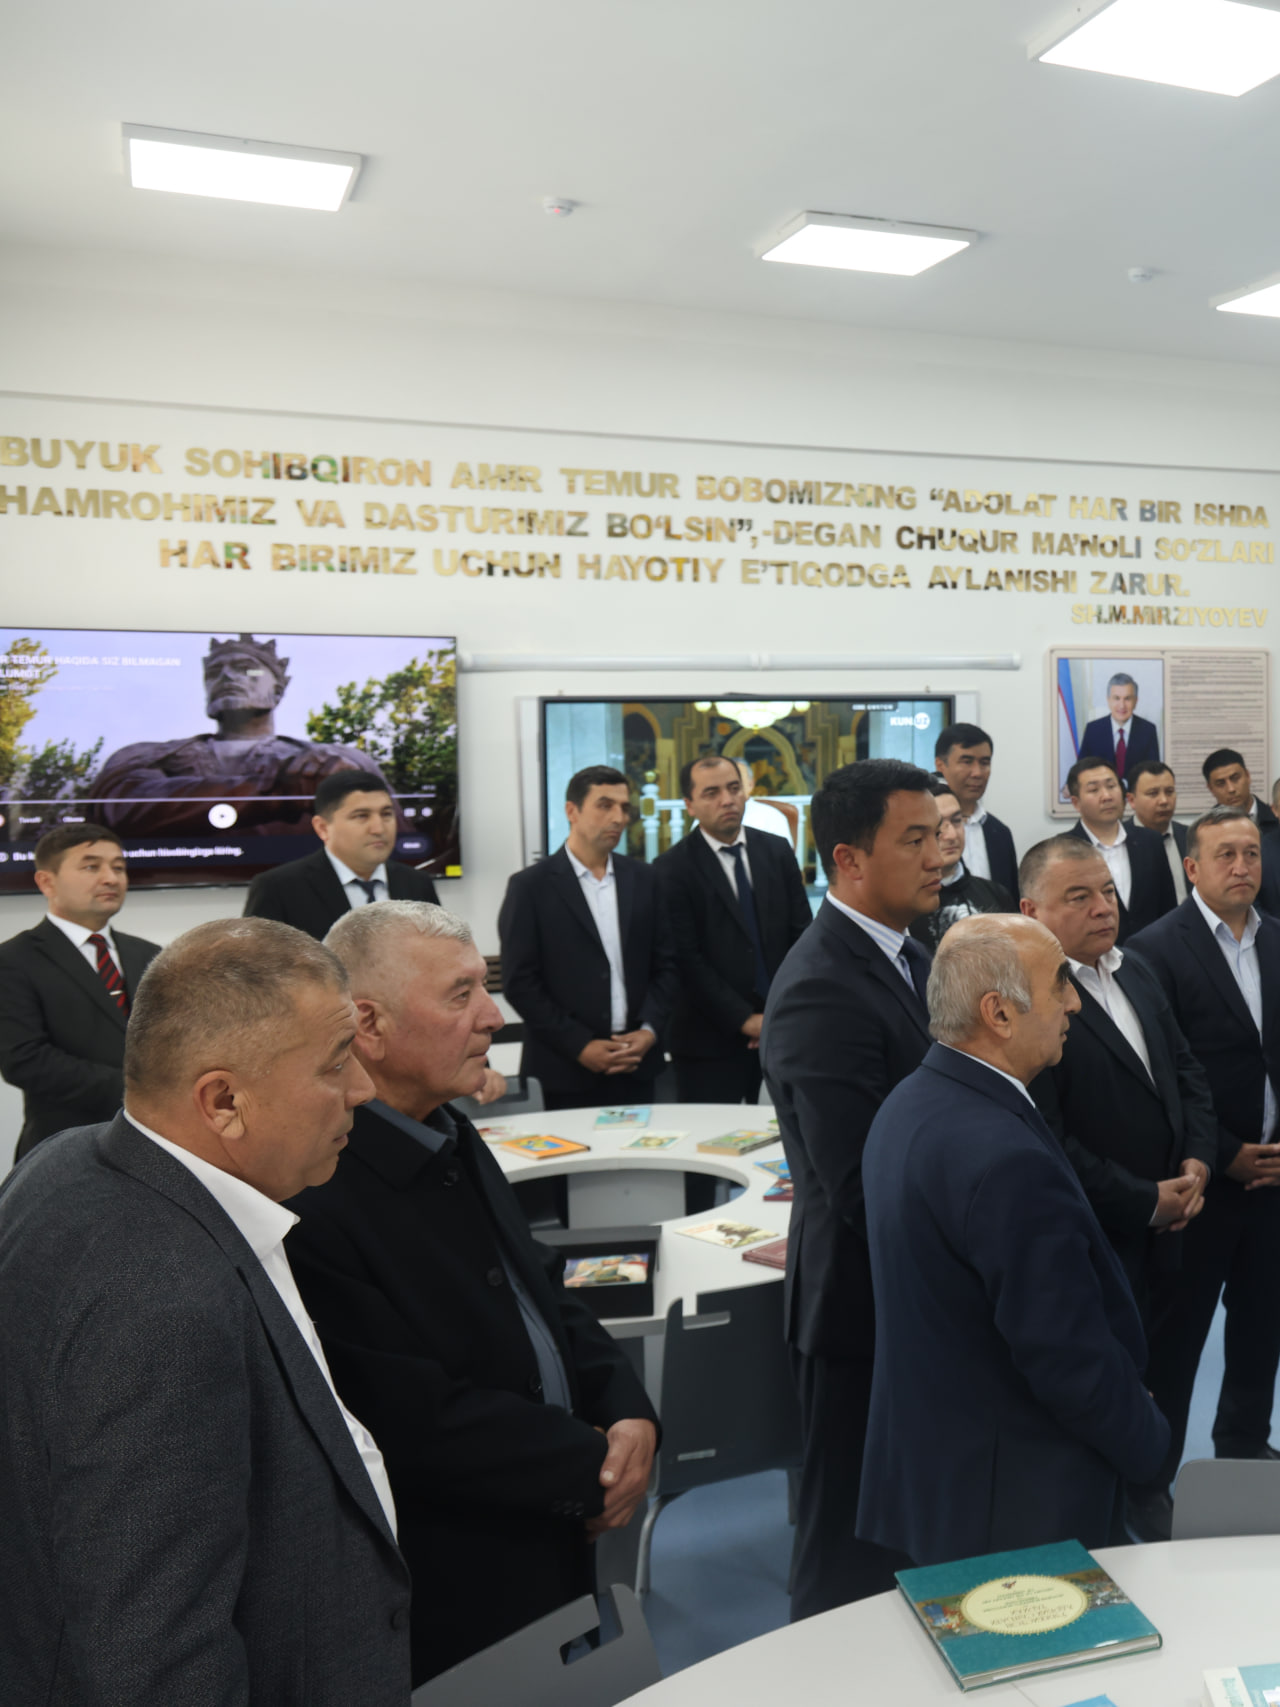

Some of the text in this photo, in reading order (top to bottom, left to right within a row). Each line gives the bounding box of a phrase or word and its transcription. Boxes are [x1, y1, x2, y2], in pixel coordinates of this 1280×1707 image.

[0, 436, 163, 474] BUYUK
[184, 447, 431, 487] SOHIBQIRON
[451, 462, 543, 493] AMIR
[559, 467, 680, 499] TEMUR
[696, 475, 917, 511] BOBOMIZNING
[1069, 495, 1128, 521] HAR
[1139, 499, 1181, 524] BIR
[1194, 503, 1270, 529] ISHDA
[0, 485, 277, 525] HAMROHIMIZ
[295, 499, 347, 529] VA
[364, 501, 589, 538] DASTURIMIZ
[895, 524, 1019, 555] CHUQUR
[158, 538, 252, 571] HAR
[271, 542, 418, 576] BIRIMIZ
[432, 548, 562, 579] UCHUN
[577, 553, 725, 583] HAYOTIY
[927, 565, 1078, 593] AYLANISHI
[1089, 571, 1191, 598] ZARUR.
